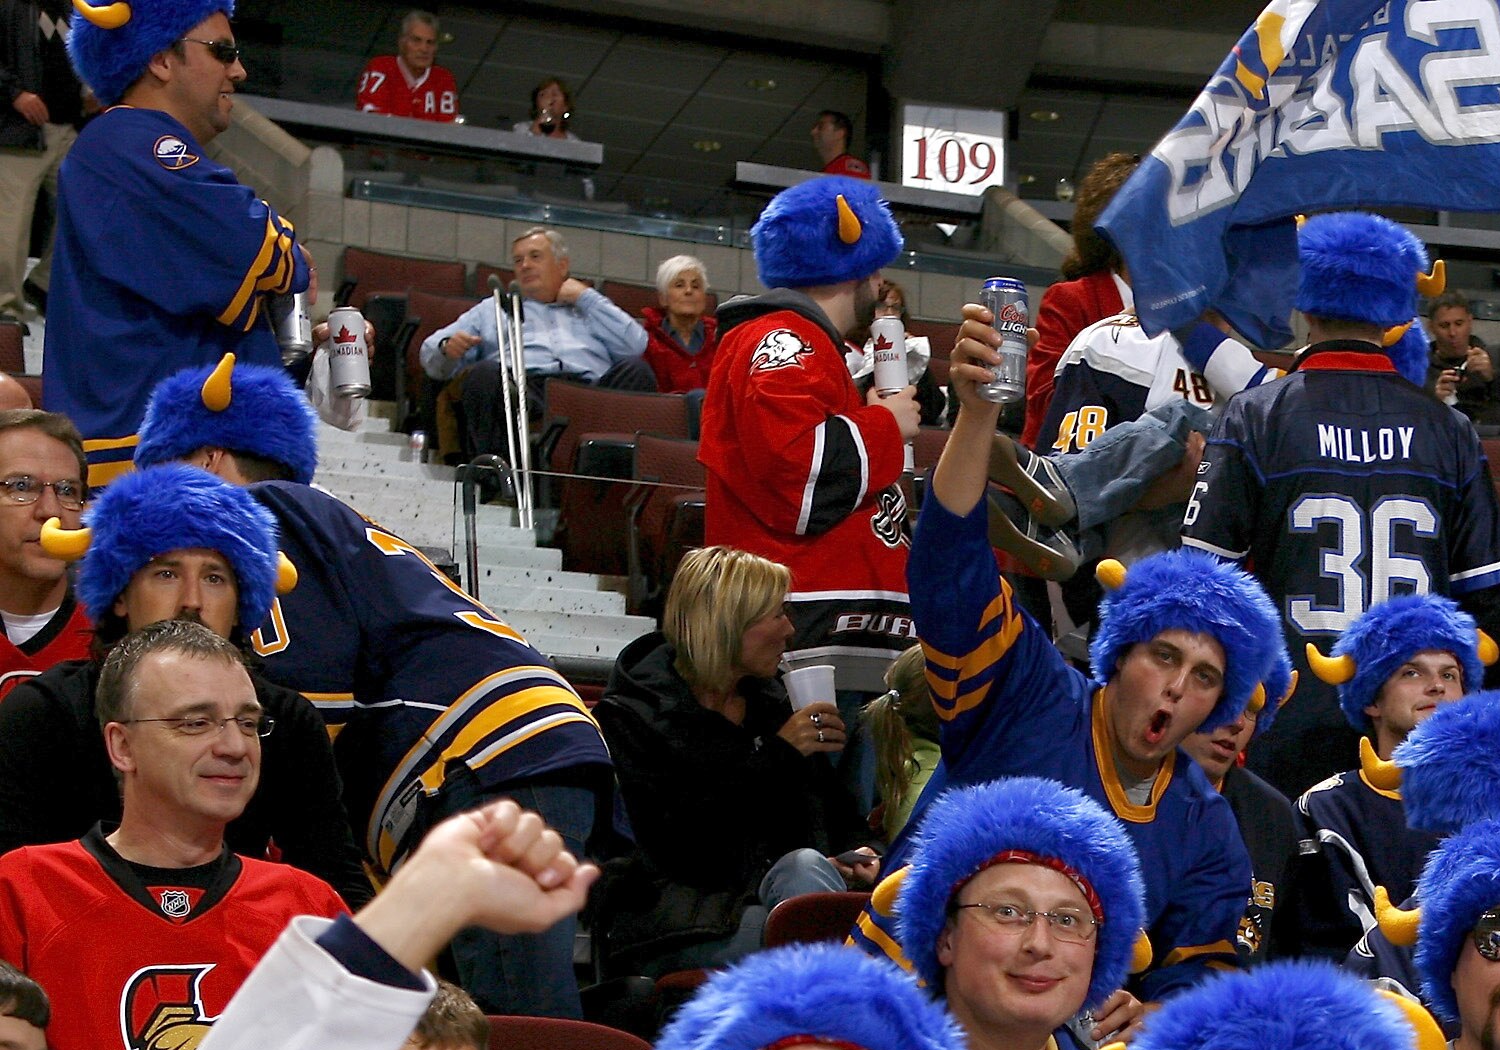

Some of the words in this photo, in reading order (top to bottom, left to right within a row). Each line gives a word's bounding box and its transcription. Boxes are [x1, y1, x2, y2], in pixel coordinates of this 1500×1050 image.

[424, 91, 435, 113] A
[910, 137, 996, 185] 109
[1172, 366, 1216, 409] 48
[1052, 405, 1108, 454] 48
[1317, 423, 1414, 463] MILLOY
[1286, 493, 1441, 636] 36
